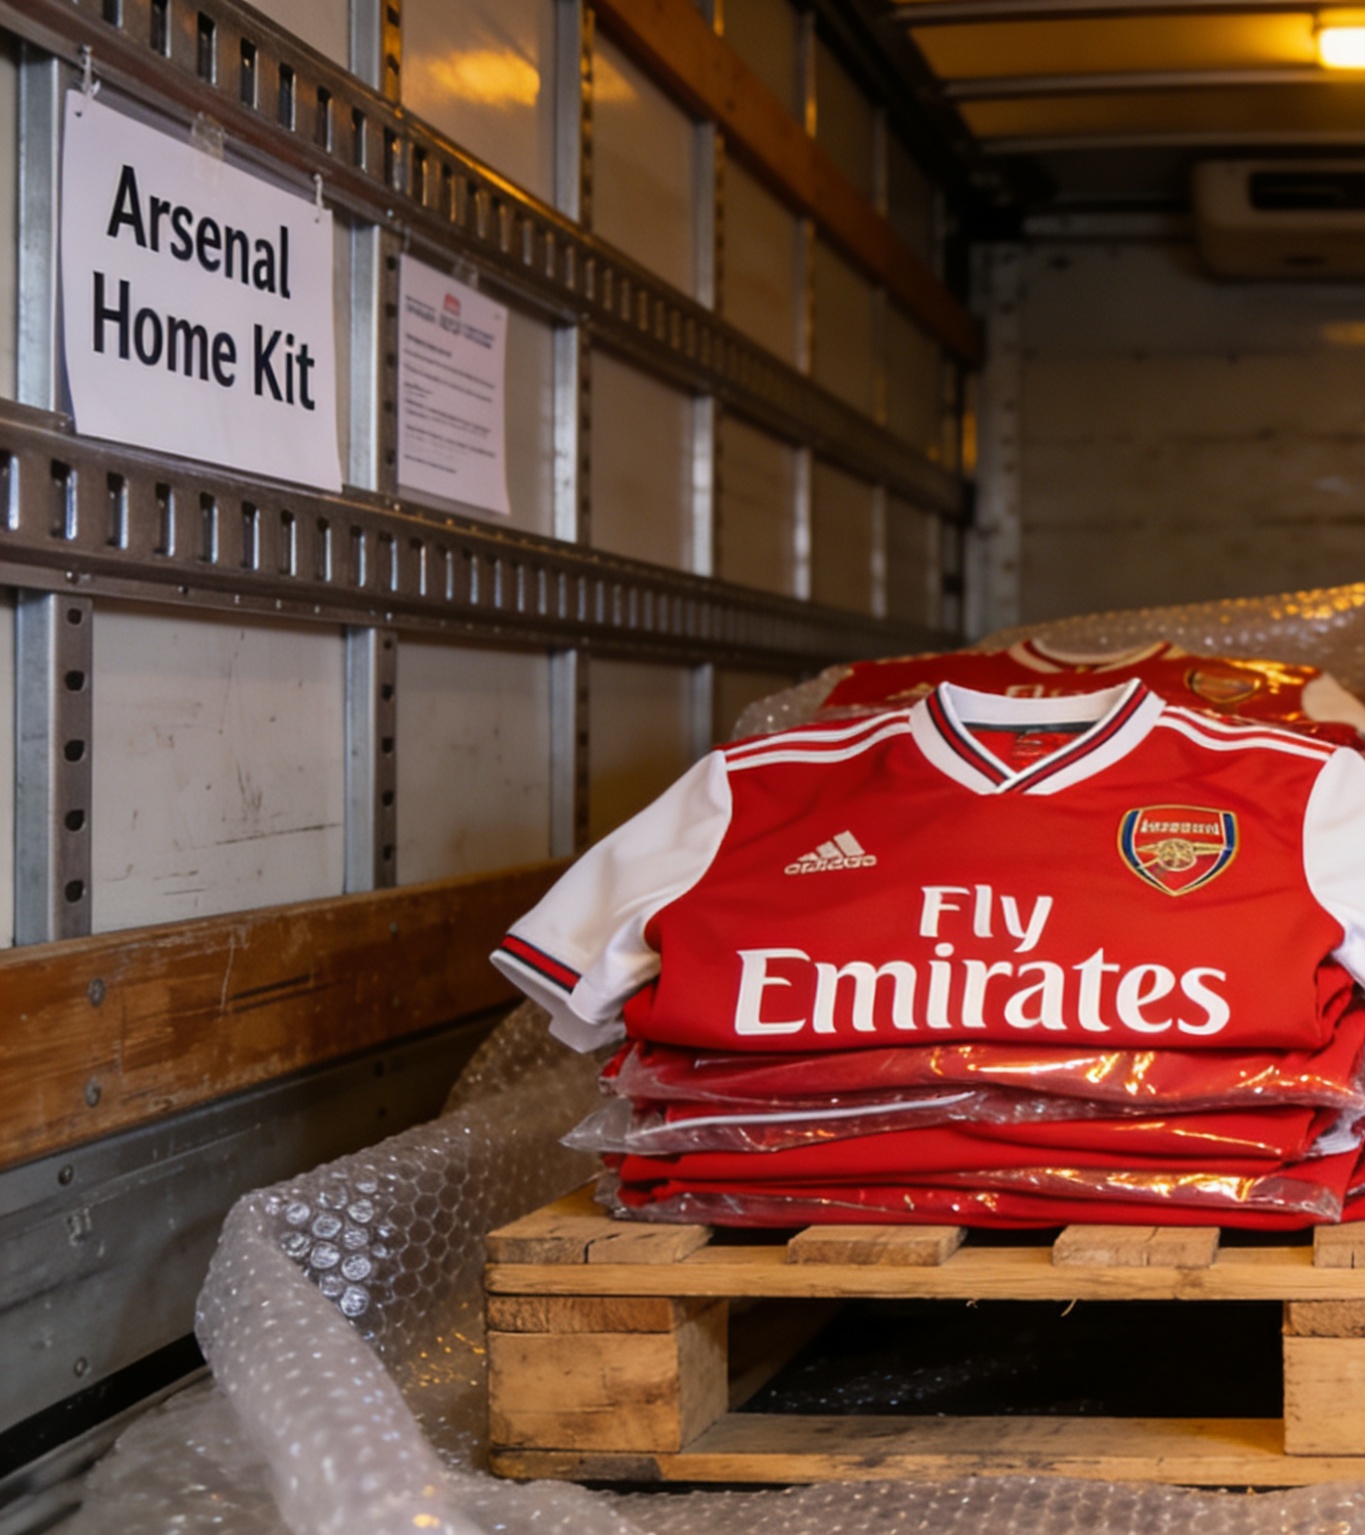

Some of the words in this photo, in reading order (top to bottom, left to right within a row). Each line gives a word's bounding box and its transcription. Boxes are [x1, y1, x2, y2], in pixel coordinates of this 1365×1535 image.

[107, 164, 291, 300] Arsenal
[92, 271, 237, 388] Home
[253, 324, 316, 412] Kit
[920, 884, 1053, 952] Fly
[735, 943, 1231, 1036] Emirates
